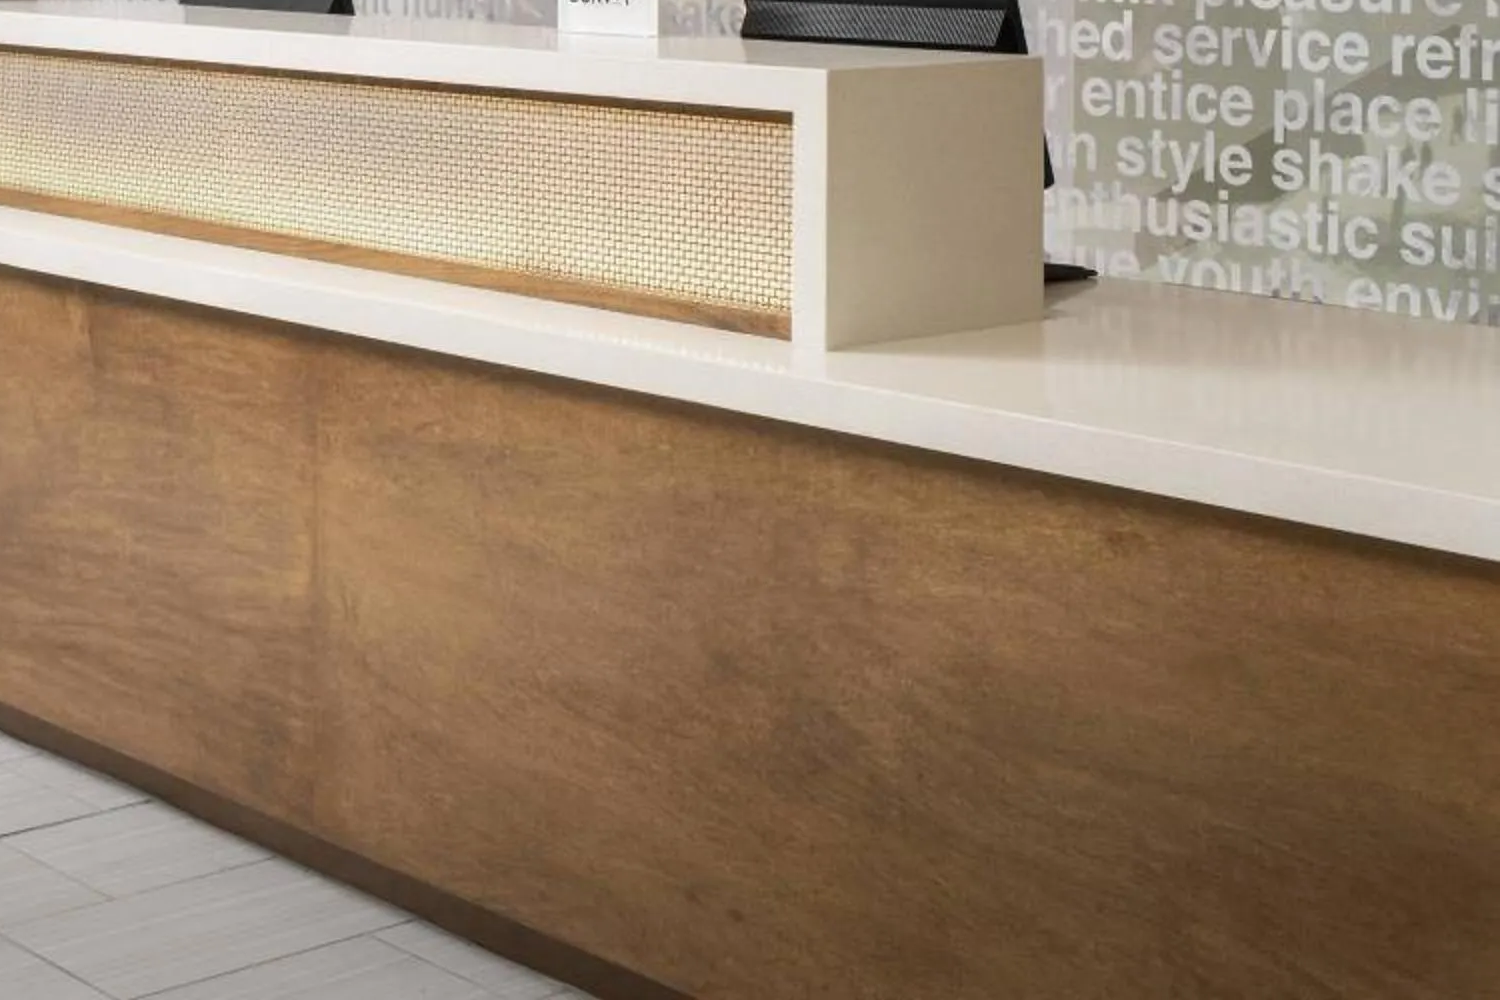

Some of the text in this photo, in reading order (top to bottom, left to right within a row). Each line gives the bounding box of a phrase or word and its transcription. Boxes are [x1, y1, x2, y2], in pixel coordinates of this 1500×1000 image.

[1153, 16, 1369, 76] service
[1081, 69, 1255, 128] entice
[1273, 77, 1443, 145] place
[1116, 128, 1255, 194] style
[1271, 137, 1462, 207] shake
